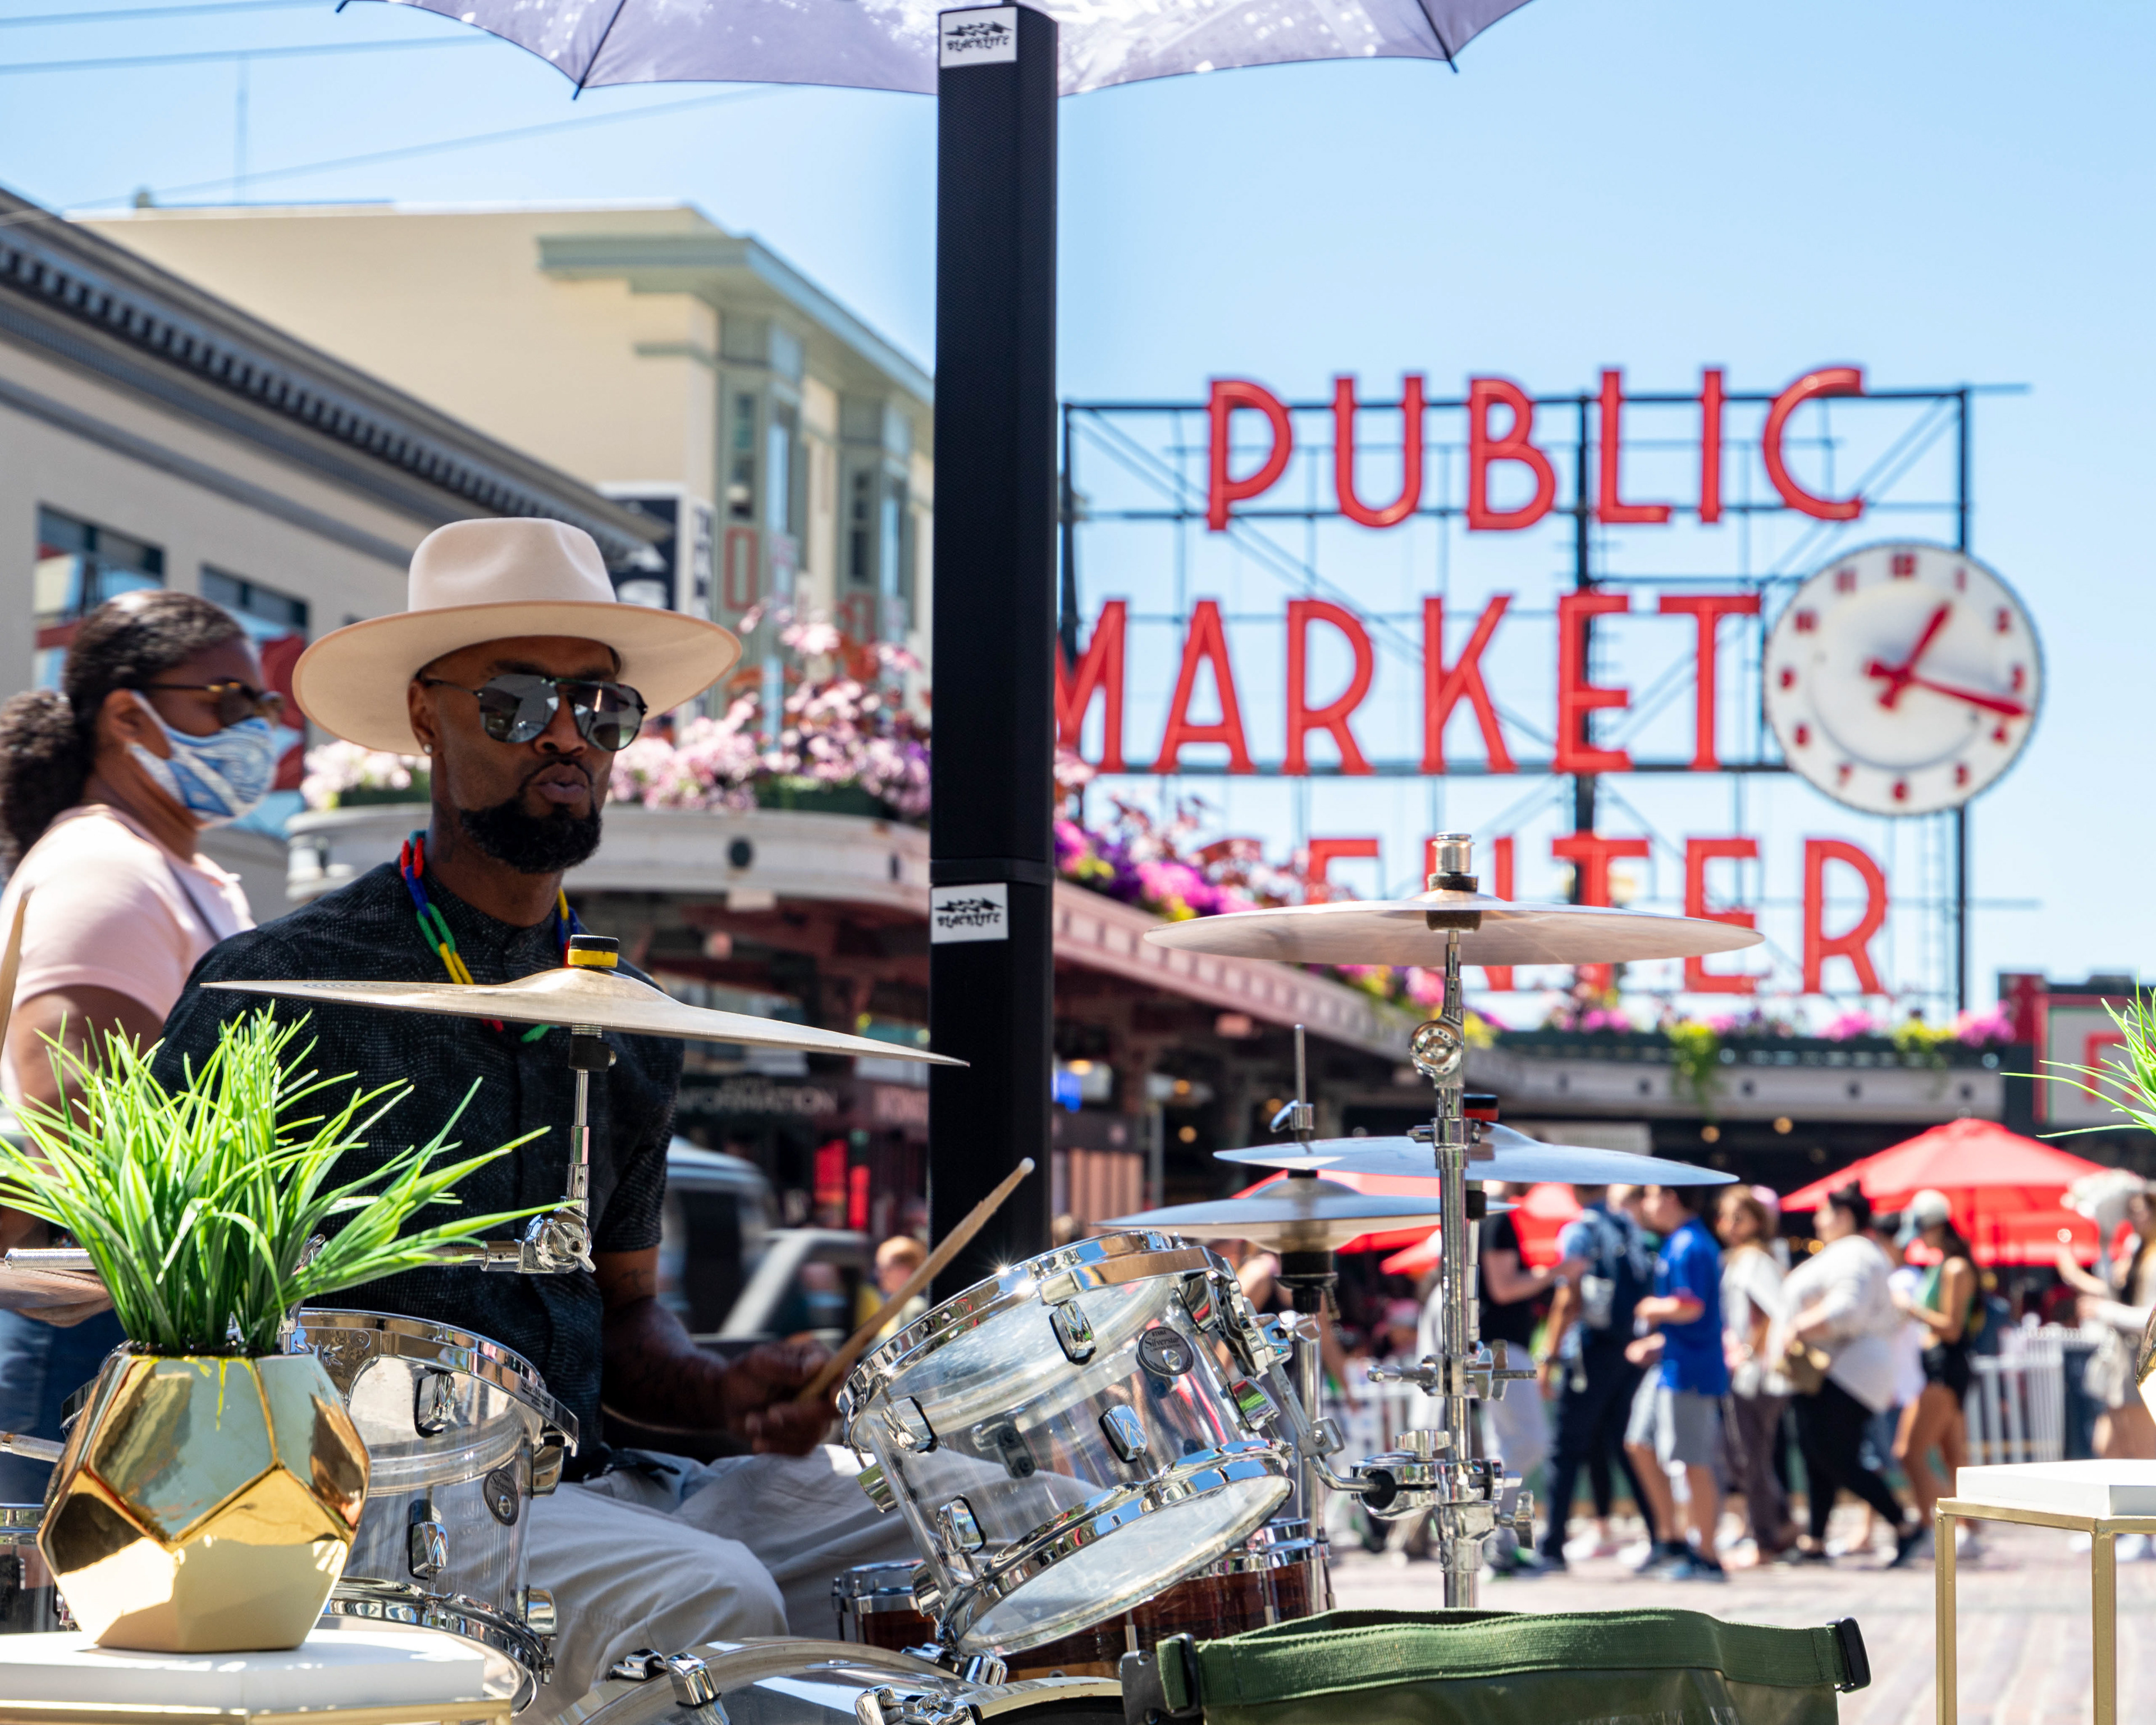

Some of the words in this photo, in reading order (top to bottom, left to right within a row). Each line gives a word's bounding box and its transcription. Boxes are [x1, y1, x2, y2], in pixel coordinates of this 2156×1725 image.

[1206, 368, 1863, 531] PUBLIC
[1054, 594, 1758, 775] MARKET
[1196, 831, 1888, 995] TER
[1145, 1338, 1179, 1349] Silverstar
